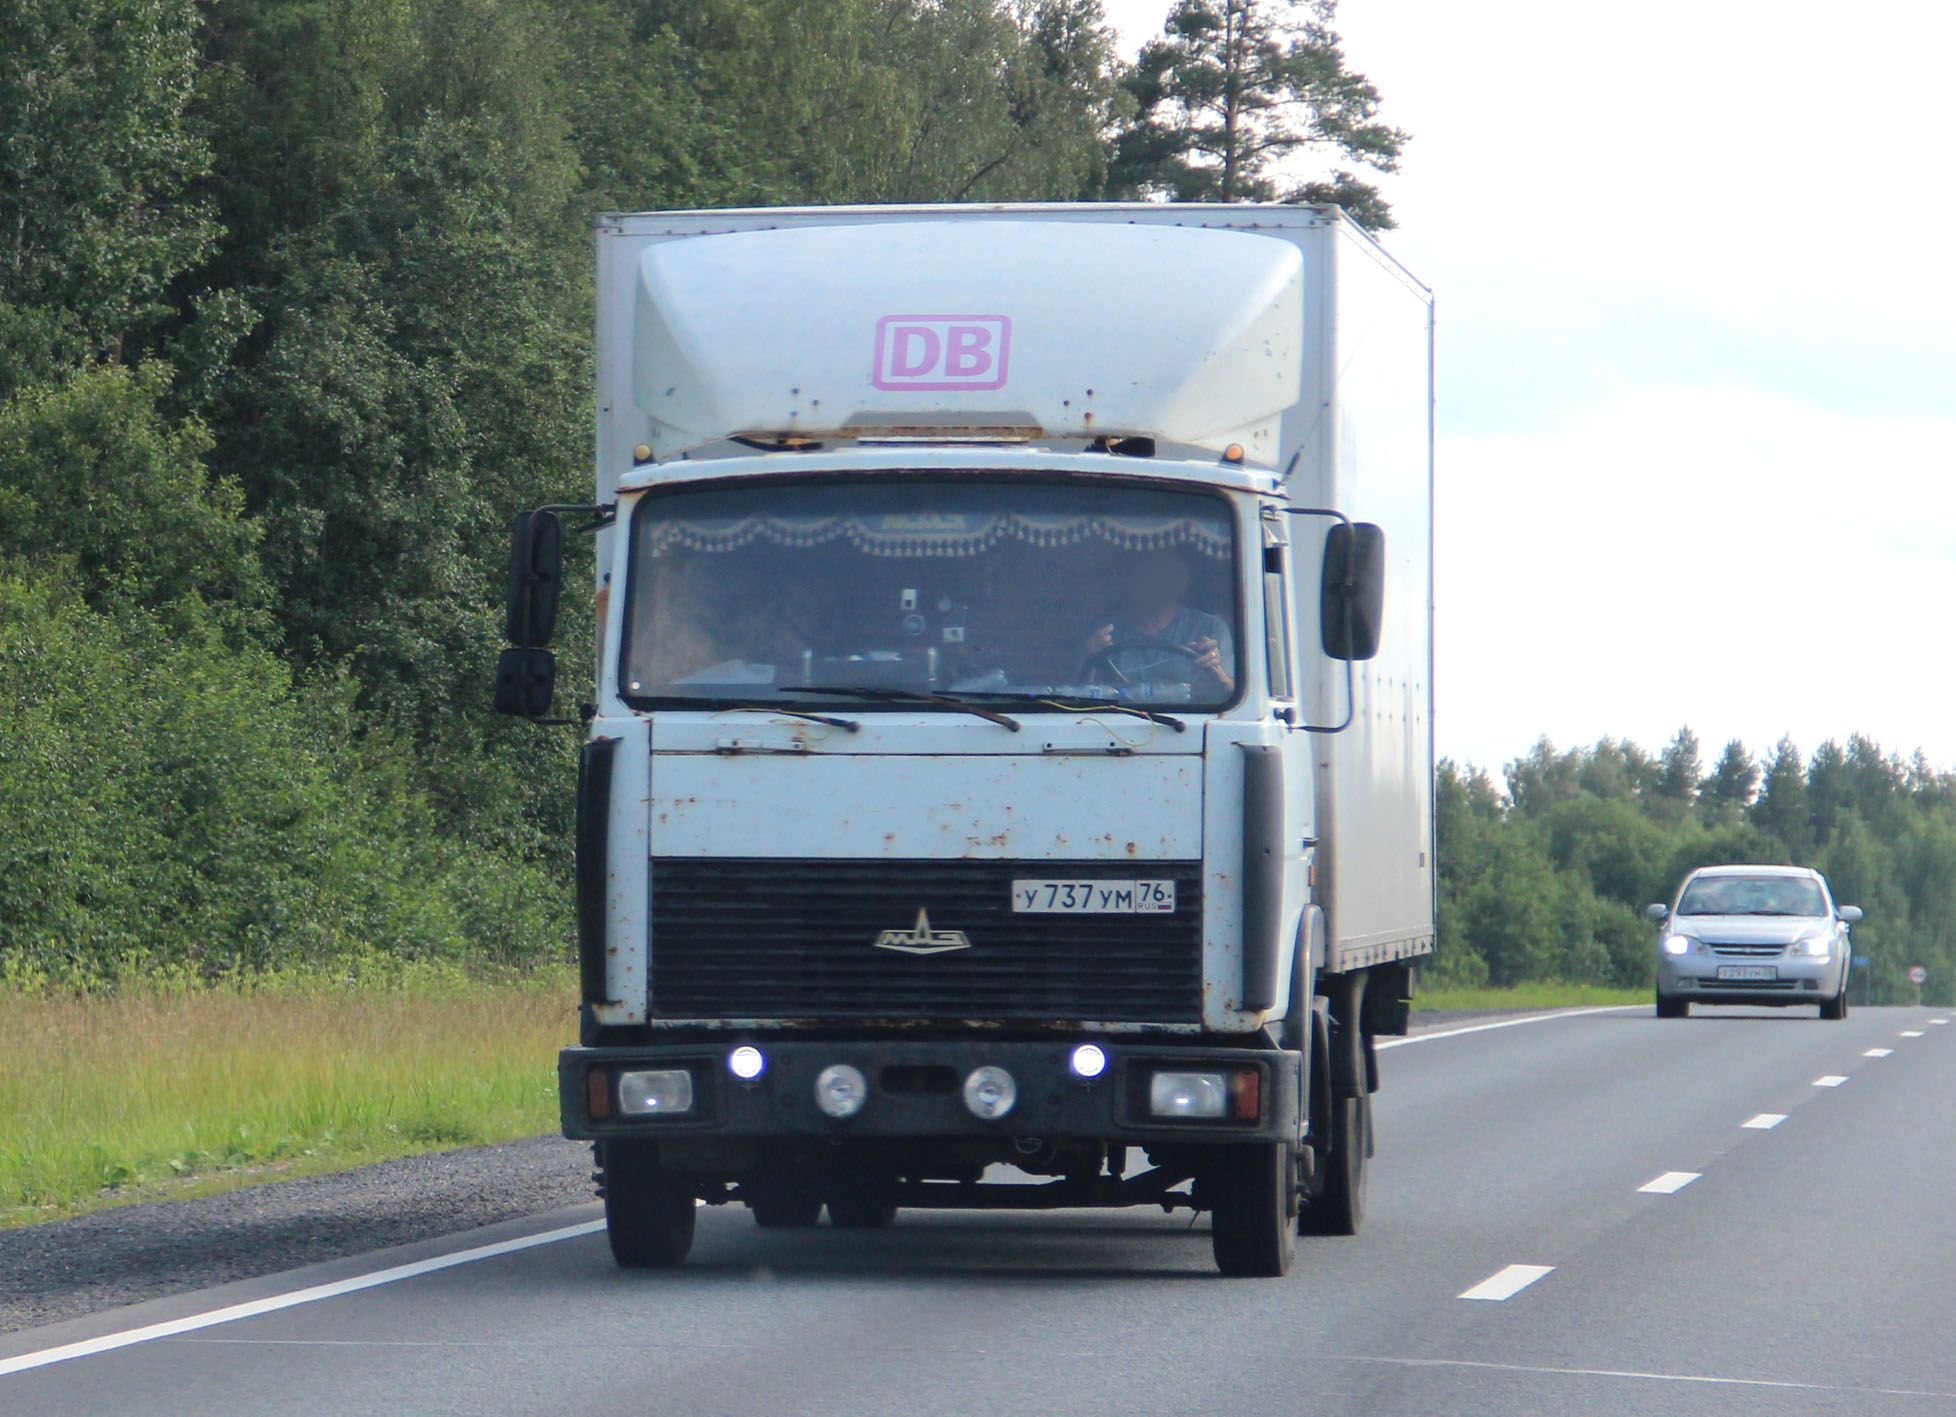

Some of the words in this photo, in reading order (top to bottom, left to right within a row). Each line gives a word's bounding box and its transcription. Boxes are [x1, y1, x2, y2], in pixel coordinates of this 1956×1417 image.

[890, 326, 992, 377] DB
[1139, 883, 1165, 902] 76
[1137, 902, 1157, 910] RUS
